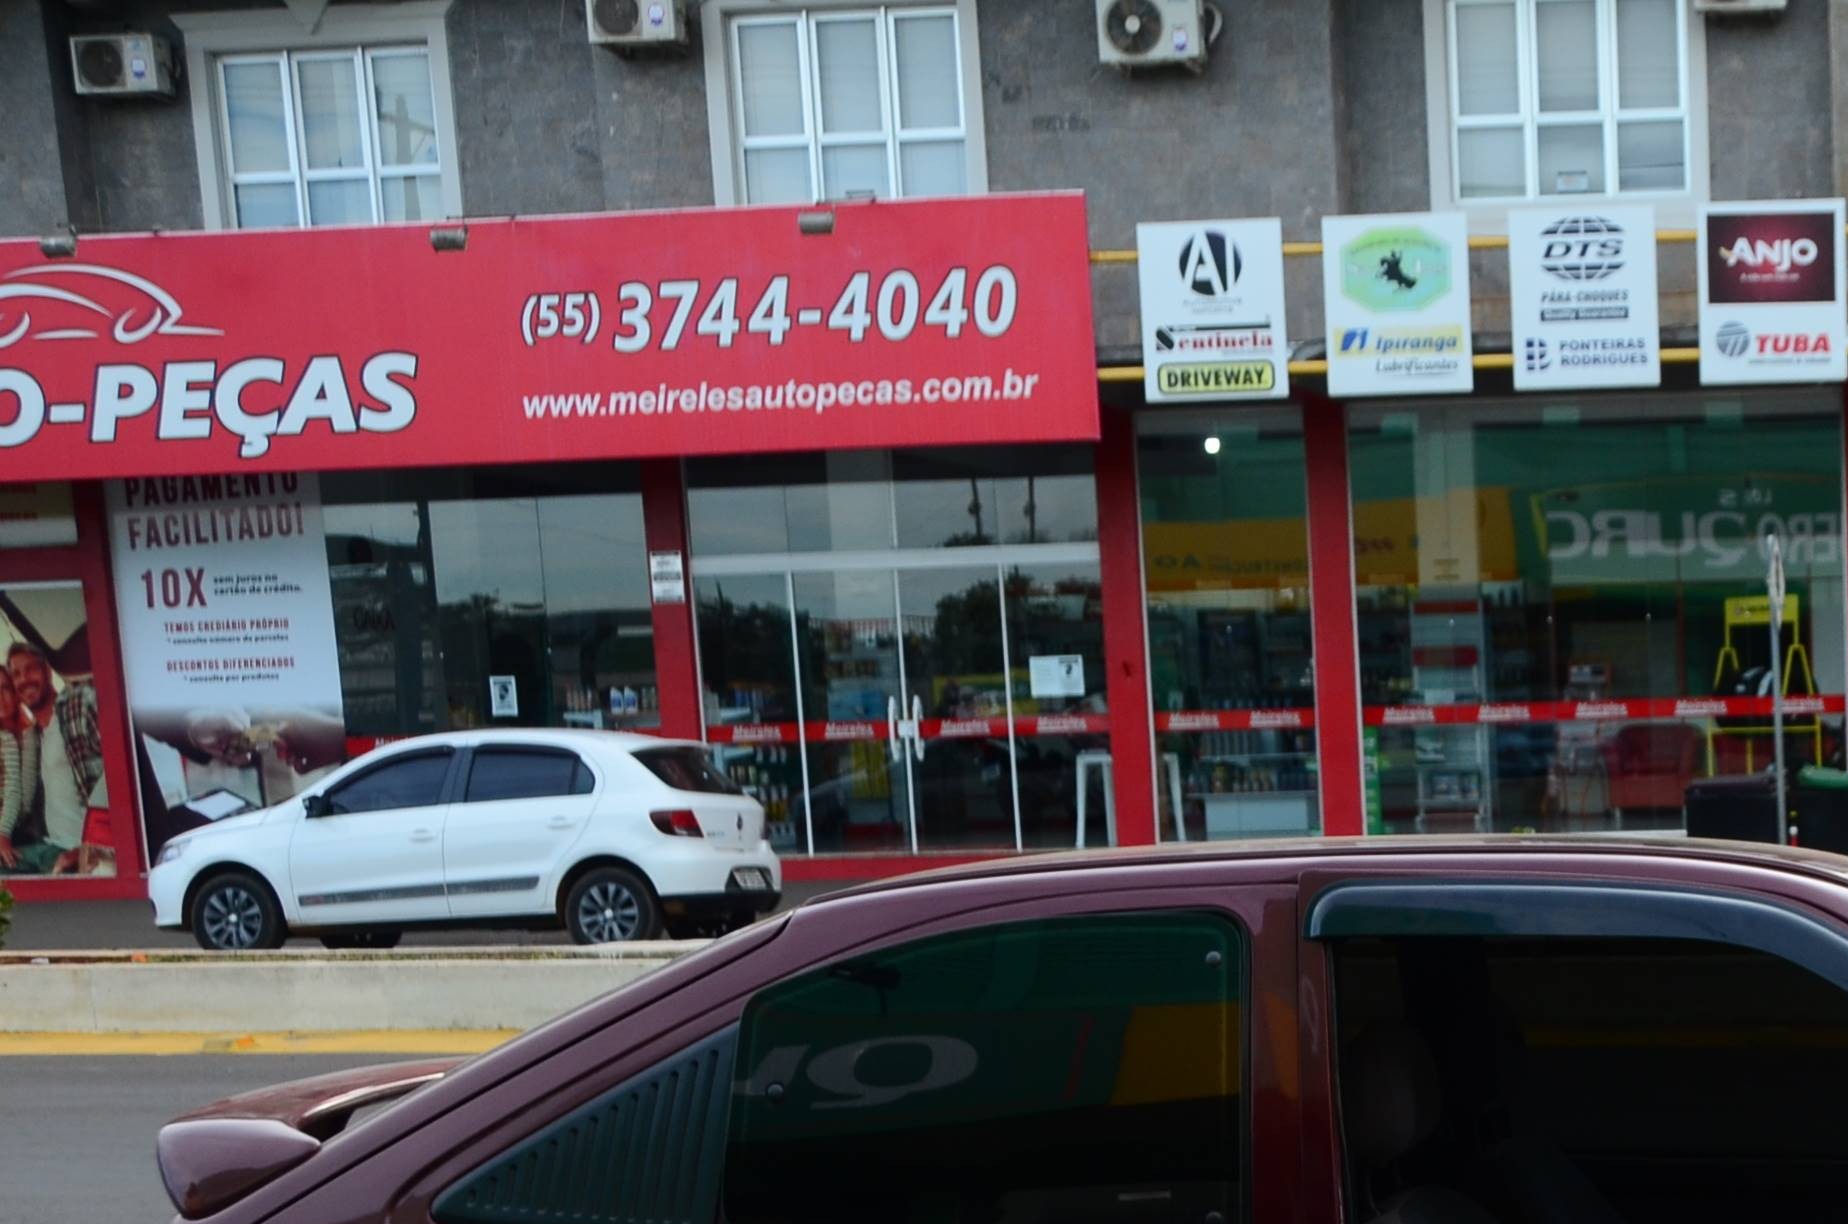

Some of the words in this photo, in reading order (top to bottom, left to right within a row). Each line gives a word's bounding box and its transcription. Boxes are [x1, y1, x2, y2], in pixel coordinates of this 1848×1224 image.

[1543, 239, 1624, 258] DTS
[1727, 236, 1818, 272] ANJO
[520, 291, 601, 346] (55)
[613, 264, 1018, 354] 3744-4040
[1156, 326, 1272, 351] Sentinela
[1559, 338, 1645, 351] PONTEIRAS
[1756, 333, 1831, 355] TUBA
[1376, 357, 1458, 374] Lubrificantes
[1561, 352, 1648, 366] RODRIGUES
[1166, 367, 1265, 388] DRIVEWAY
[522, 368, 1038, 419] www.meirelesautopecas.com.br
[125, 474, 298, 507] PAGAMENTO
[127, 502, 304, 551] FACILITADO!
[141, 567, 207, 609] 10X
[164, 620, 195, 633] TEMOS
[166, 659, 220, 673] DESCONTOS
[223, 656, 295, 671] DIFERENCIADOS
